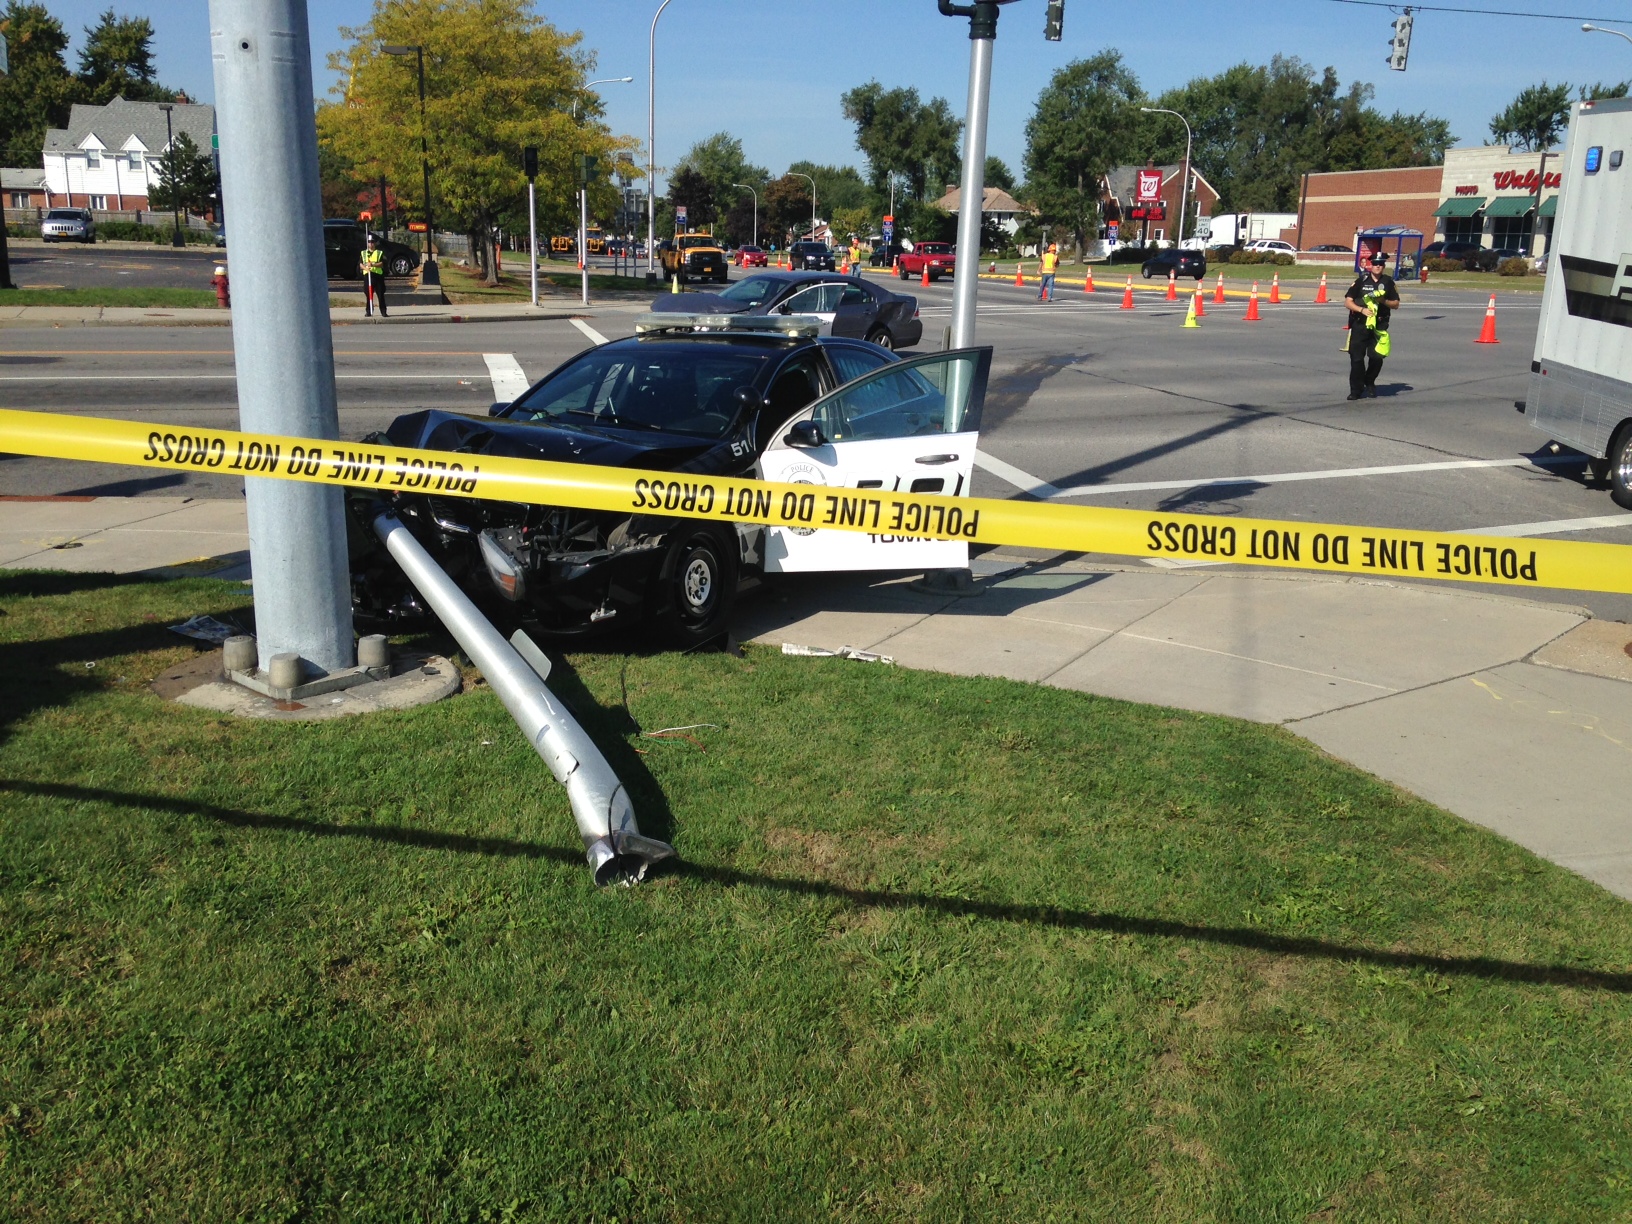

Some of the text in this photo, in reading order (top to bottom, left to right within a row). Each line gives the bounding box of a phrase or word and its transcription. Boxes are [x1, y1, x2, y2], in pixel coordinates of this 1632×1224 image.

[1455, 185, 1479, 196] PHOTO
[1197, 227, 1209, 235] 40
[730, 439, 750, 457] 51
[143, 432, 480, 493] POLICE LINE DO NOT CROSS
[790, 465, 815, 473] POLICE
[632, 478, 980, 538] POLICE LINE DO NOT CROSS
[1147, 520, 1538, 581] POLICE LINE DO NOT CROSS
